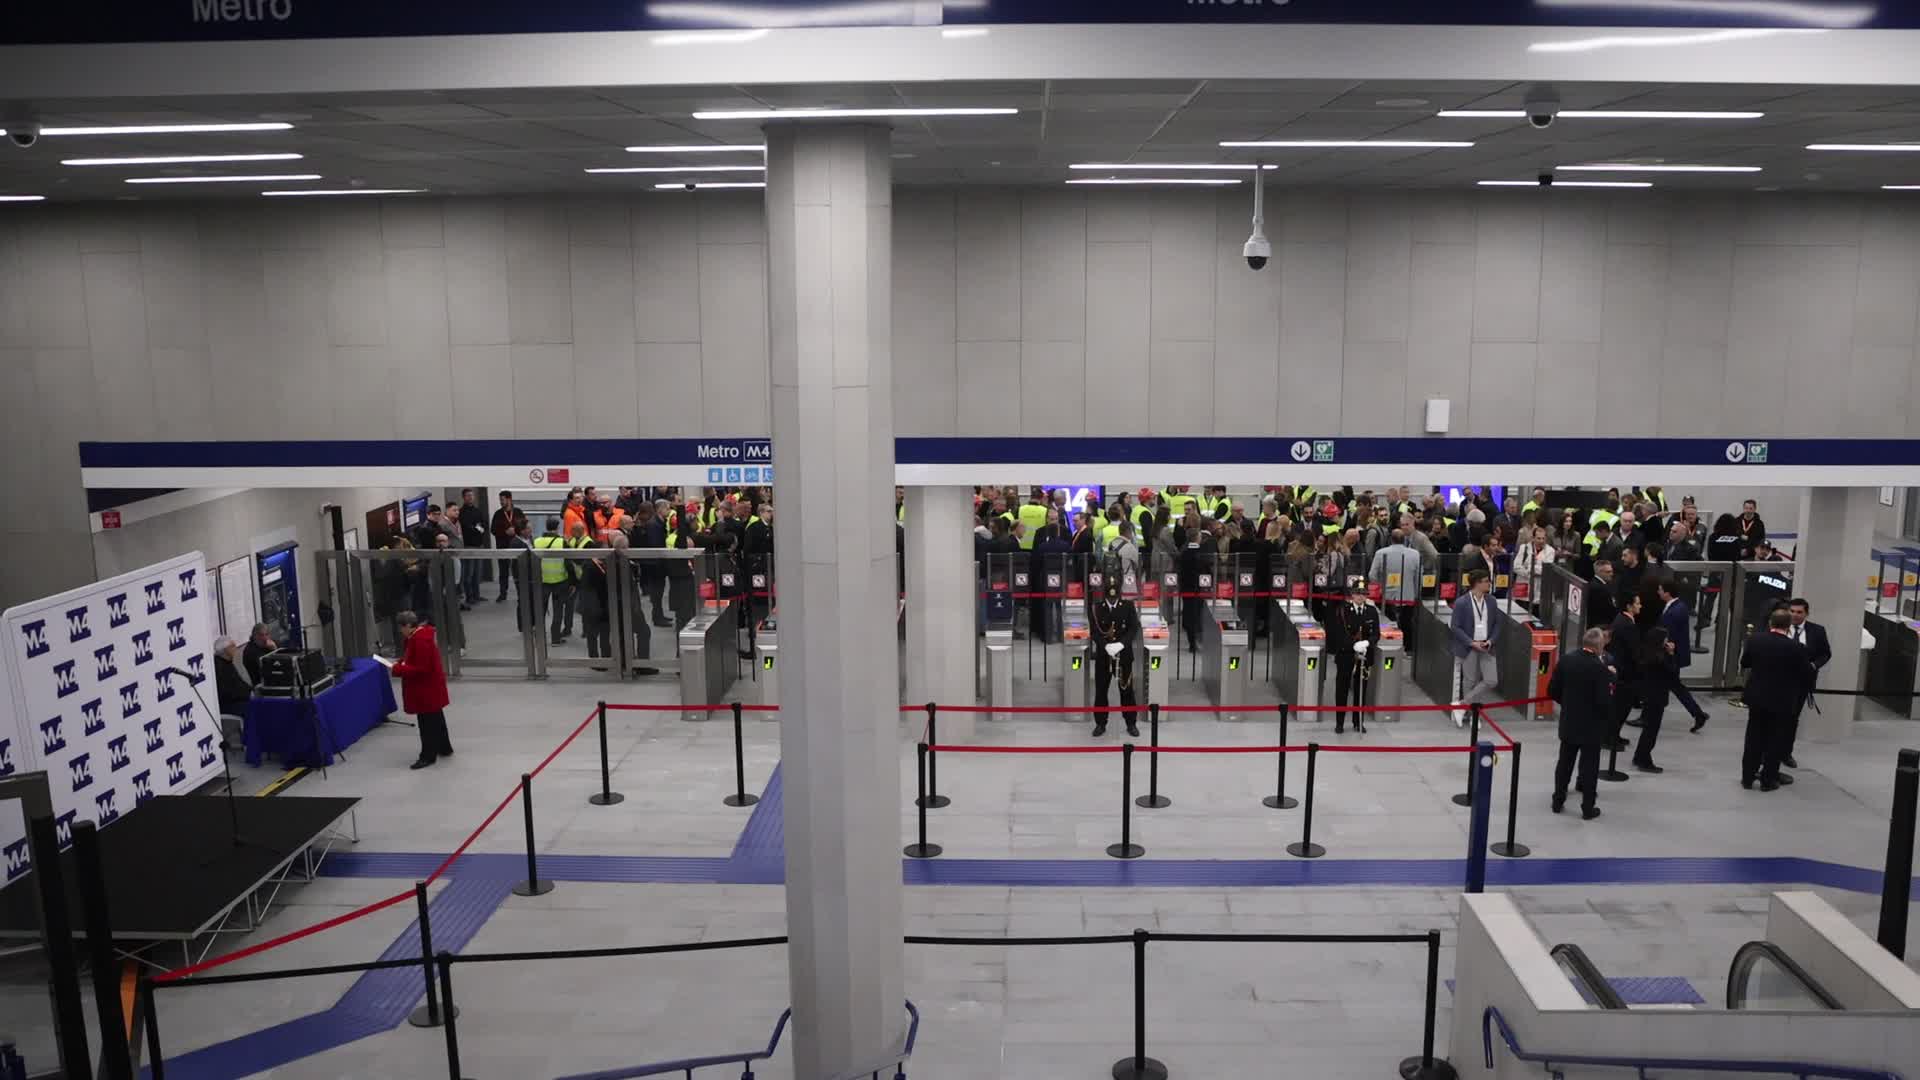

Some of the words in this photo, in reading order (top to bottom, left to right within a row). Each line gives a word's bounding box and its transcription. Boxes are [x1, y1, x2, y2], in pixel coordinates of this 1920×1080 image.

[697, 445, 739, 458] Metro
[747, 445, 770, 457] M4
[179, 572, 198, 597] M4
[1759, 575, 1786, 590] POLIZIA
[107, 596, 130, 623] M4
[144, 584, 166, 611] M4
[66, 610, 91, 637] M4
[167, 621, 186, 647] M4
[22, 624, 50, 653] M4
[132, 633, 153, 660] M4
[94, 648, 118, 675] M4
[53, 664, 79, 693] M4
[155, 670, 175, 697] M4
[120, 686, 141, 713] M4
[81, 701, 105, 730] M4
[177, 705, 196, 731] M4
[40, 719, 66, 750] M4
[143, 721, 164, 748] M4
[107, 739, 130, 766] M4
[197, 738, 216, 763] M4
[69, 757, 93, 787] M4
[166, 755, 186, 782] M4
[132, 774, 153, 802] M4
[96, 793, 119, 821] M4
[5, 843, 31, 872] M4
